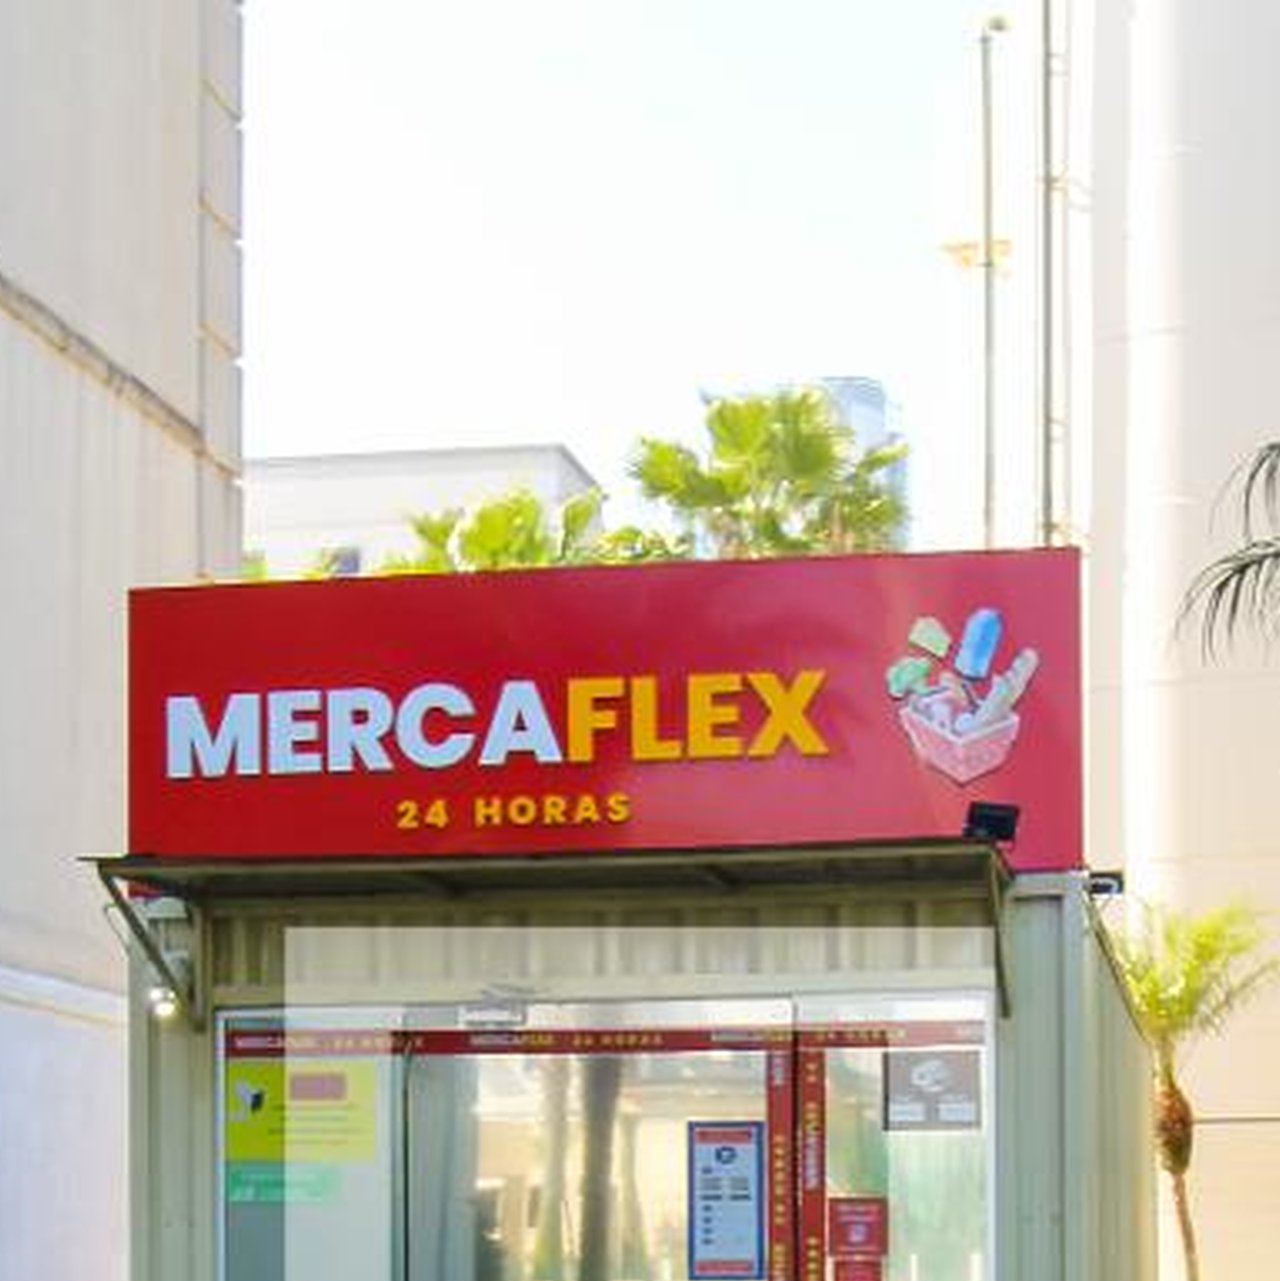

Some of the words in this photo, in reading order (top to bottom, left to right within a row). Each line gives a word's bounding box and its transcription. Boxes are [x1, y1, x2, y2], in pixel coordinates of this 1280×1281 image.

[165, 669, 830, 779] MERCAFLEX
[396, 799, 450, 829] 24
[474, 792, 632, 827] HORAS
